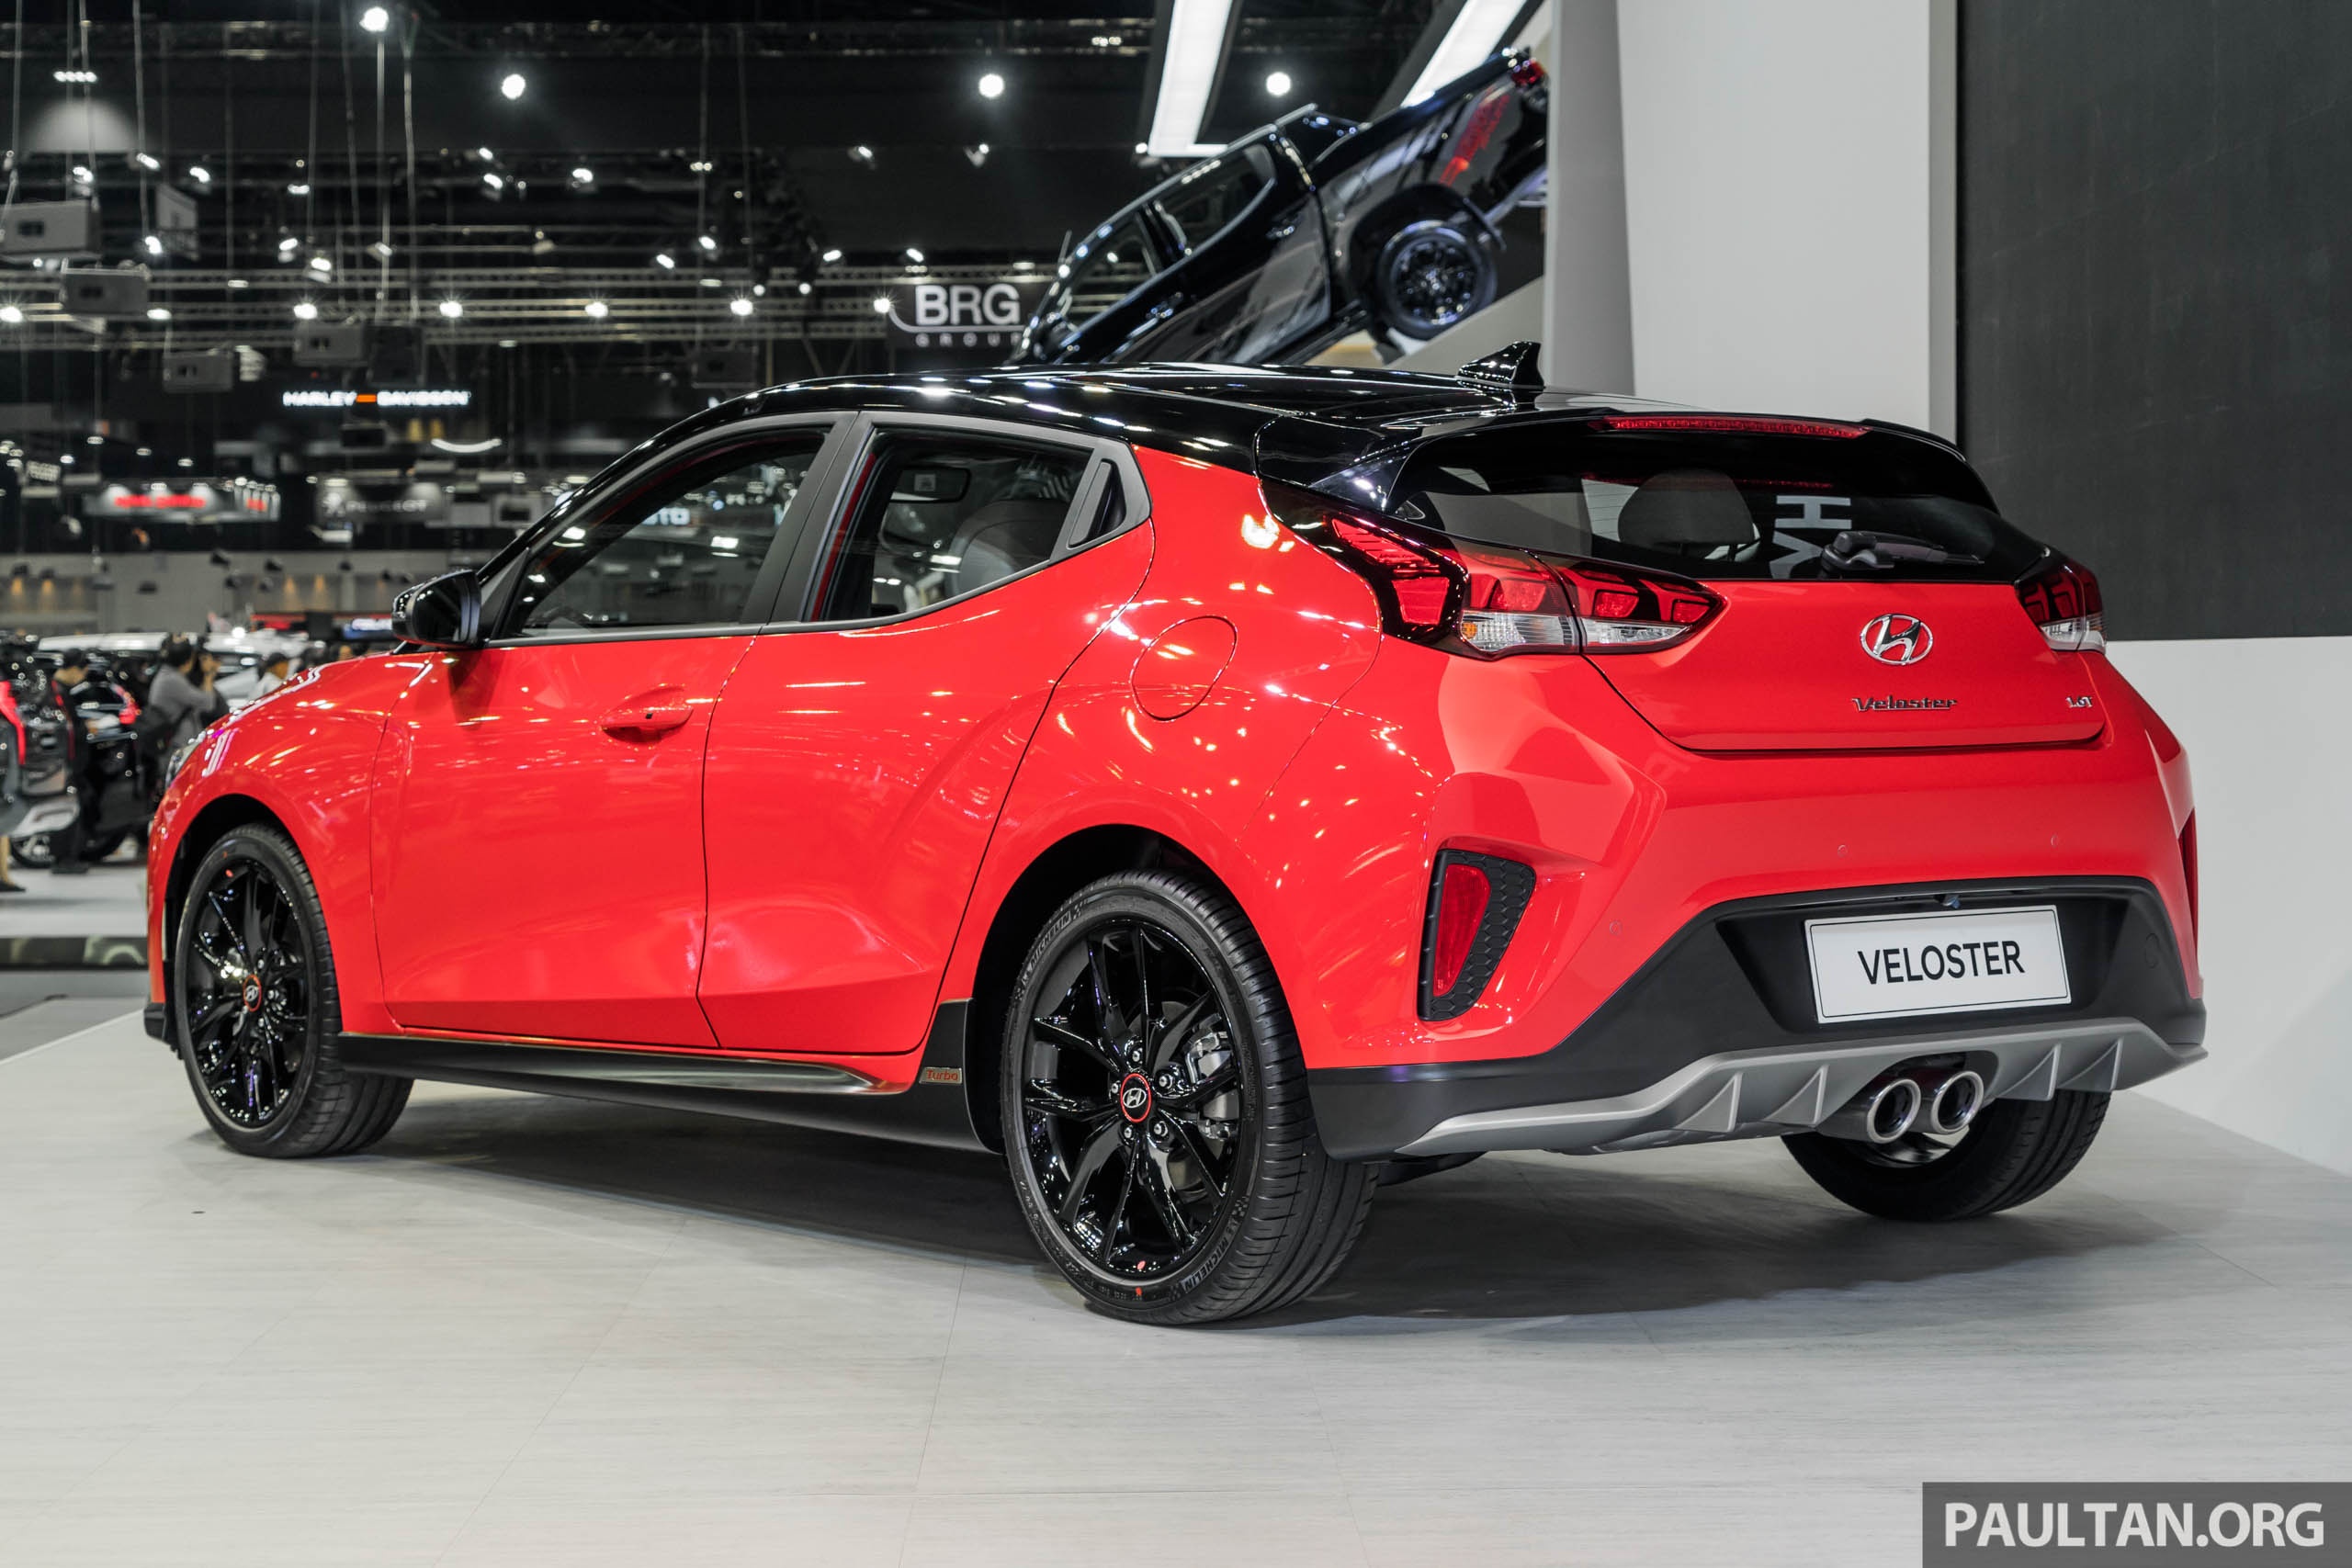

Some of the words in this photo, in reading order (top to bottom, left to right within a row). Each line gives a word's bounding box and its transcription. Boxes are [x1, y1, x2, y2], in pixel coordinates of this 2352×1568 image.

[915, 284, 1021, 325] BRG
[1852, 696, 1957, 712] Veloster
[1030, 910, 1071, 970] MICHELIN
[1857, 940, 2025, 985] VELOSTER
[926, 1069, 958, 1081] Turbo
[1182, 1235, 1231, 1292] MICHELIN
